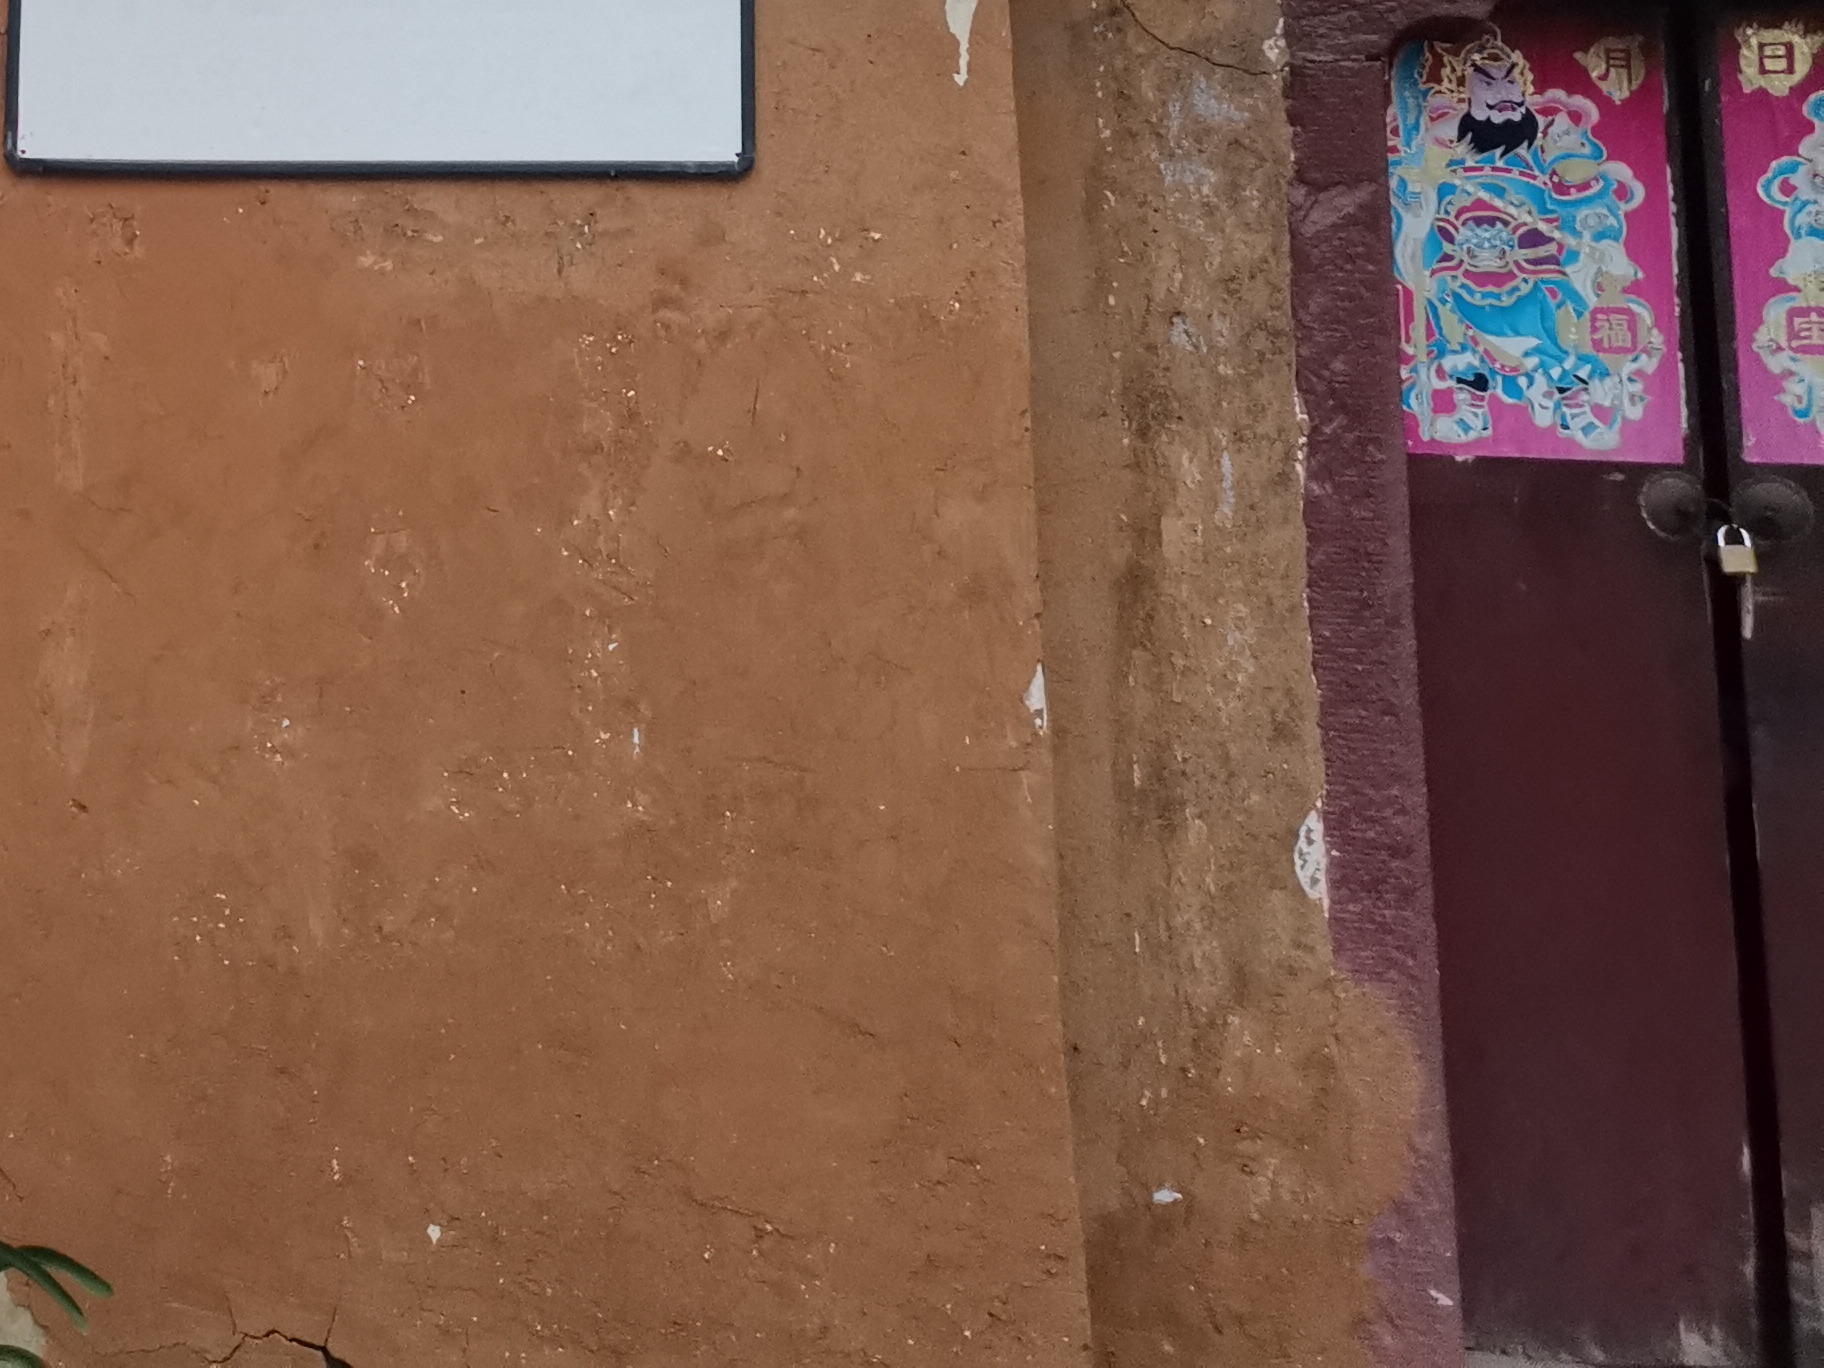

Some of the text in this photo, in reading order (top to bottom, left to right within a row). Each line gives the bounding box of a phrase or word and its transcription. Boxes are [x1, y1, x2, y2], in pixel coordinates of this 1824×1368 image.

[1597, 47, 1632, 93] 月
[1757, 40, 1795, 75] 日
[1591, 313, 1632, 348] 福
